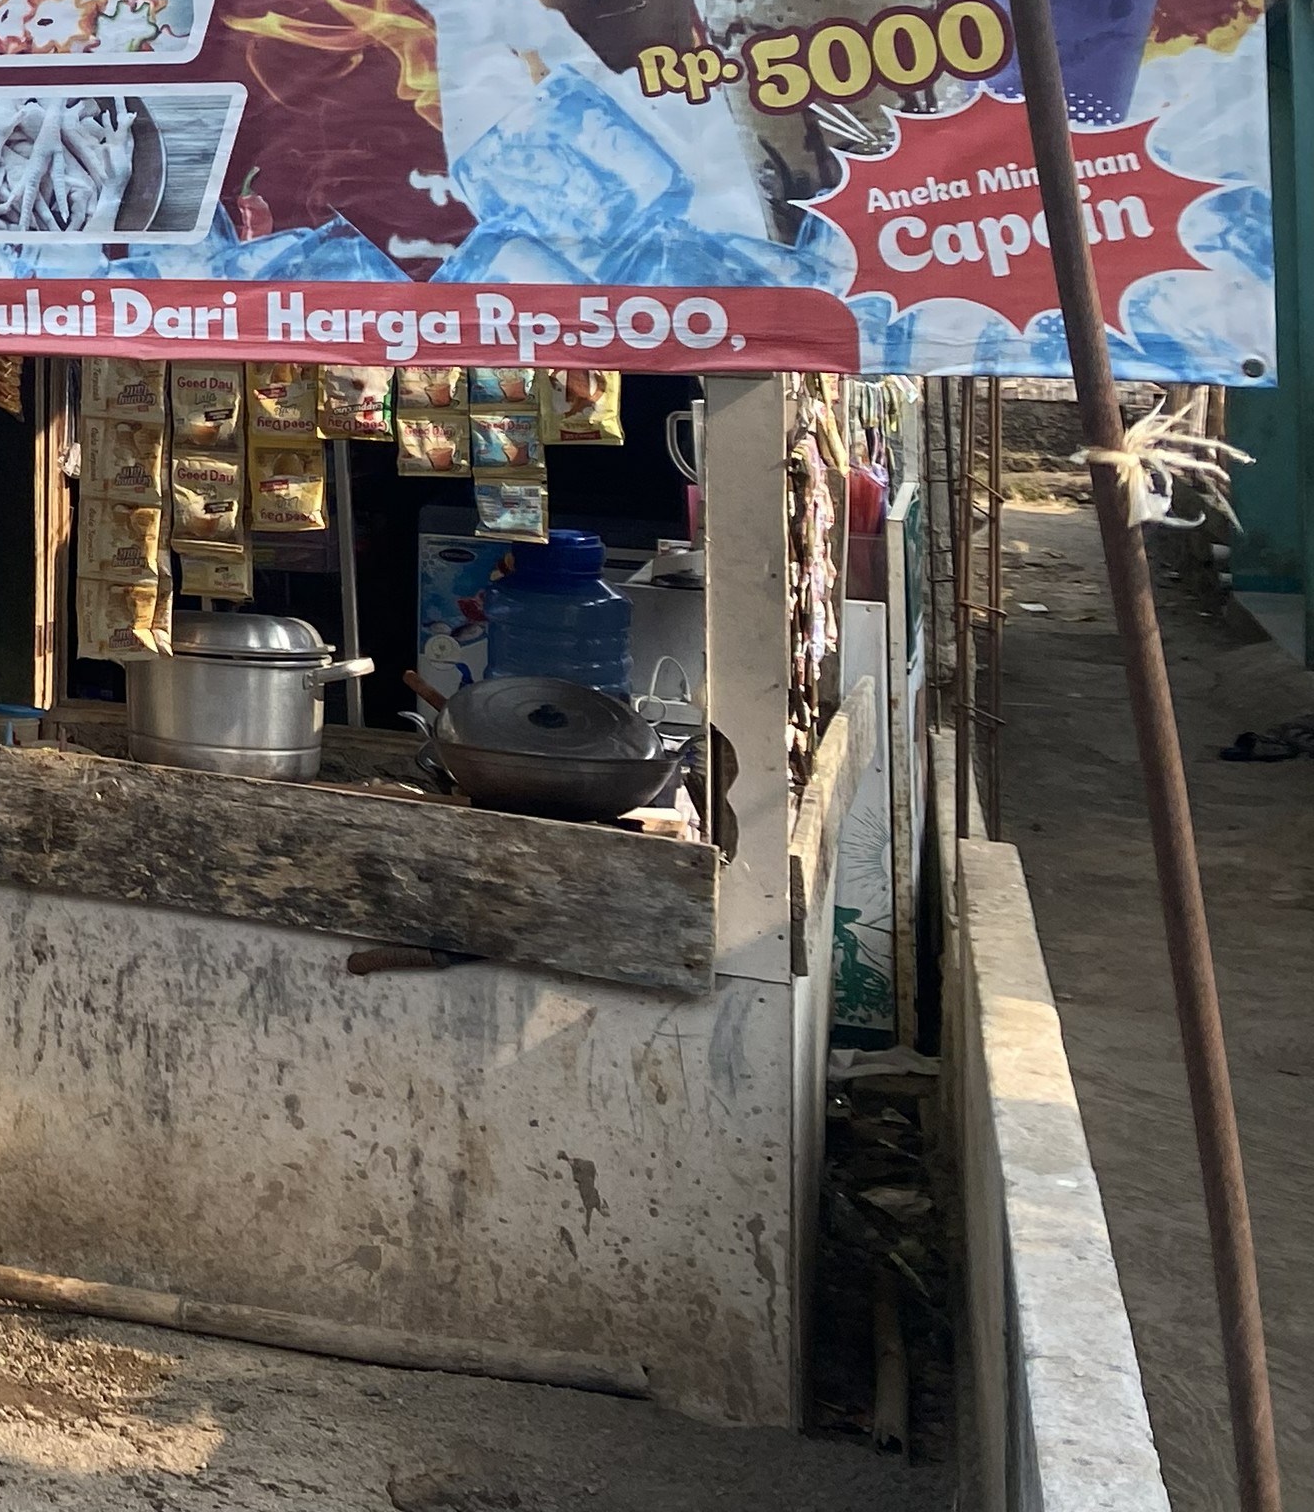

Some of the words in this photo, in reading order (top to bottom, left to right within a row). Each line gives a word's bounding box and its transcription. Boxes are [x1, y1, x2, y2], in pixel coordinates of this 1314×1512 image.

[867, 176, 973, 215] Aneka
[109, 287, 240, 341] Dari
[266, 291, 462, 361] Harga
[209, 377, 233, 393] Day
